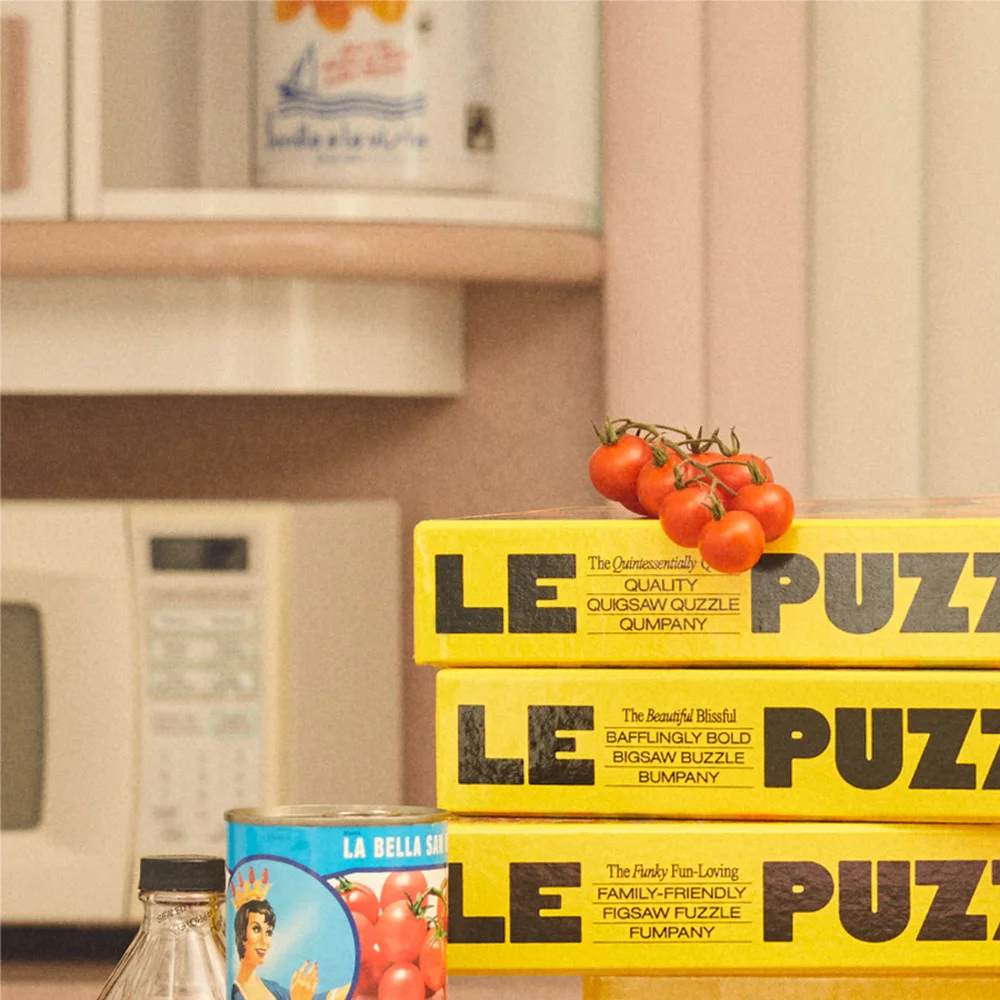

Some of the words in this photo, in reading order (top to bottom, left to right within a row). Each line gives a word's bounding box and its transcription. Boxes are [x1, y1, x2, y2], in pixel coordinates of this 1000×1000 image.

[588, 555, 611, 570] The
[612, 555, 697, 573] Quintessentially
[624, 578, 698, 592] QUALITY
[435, 553, 577, 634] LE
[587, 598, 668, 612] QUIGSAW
[670, 598, 741, 612] QUZZLE
[620, 617, 709, 631] QUMPANY
[622, 708, 643, 722] The
[646, 708, 694, 724] Beautiful
[696, 708, 736, 723] Blissful
[457, 704, 595, 785] LE
[606, 731, 702, 744] BAFFLINGLY
[706, 732, 751, 744] BOLD
[613, 751, 677, 764] BIGSAW
[681, 751, 745, 764] BUZZLE
[638, 770, 720, 783] BUMPANY
[343, 837, 366, 859] LA
[374, 834, 422, 858] BELLA
[607, 864, 631, 878] The
[632, 864, 668, 881] Funky
[671, 865, 739, 881] Fun-Loving
[598, 887, 747, 899] FAMILY-FRIENDLY
[448, 862, 582, 943] LE
[604, 906, 671, 919] FIGSAW
[675, 907, 742, 919] FUZZLE
[630, 926, 715, 939] FUMPANY
